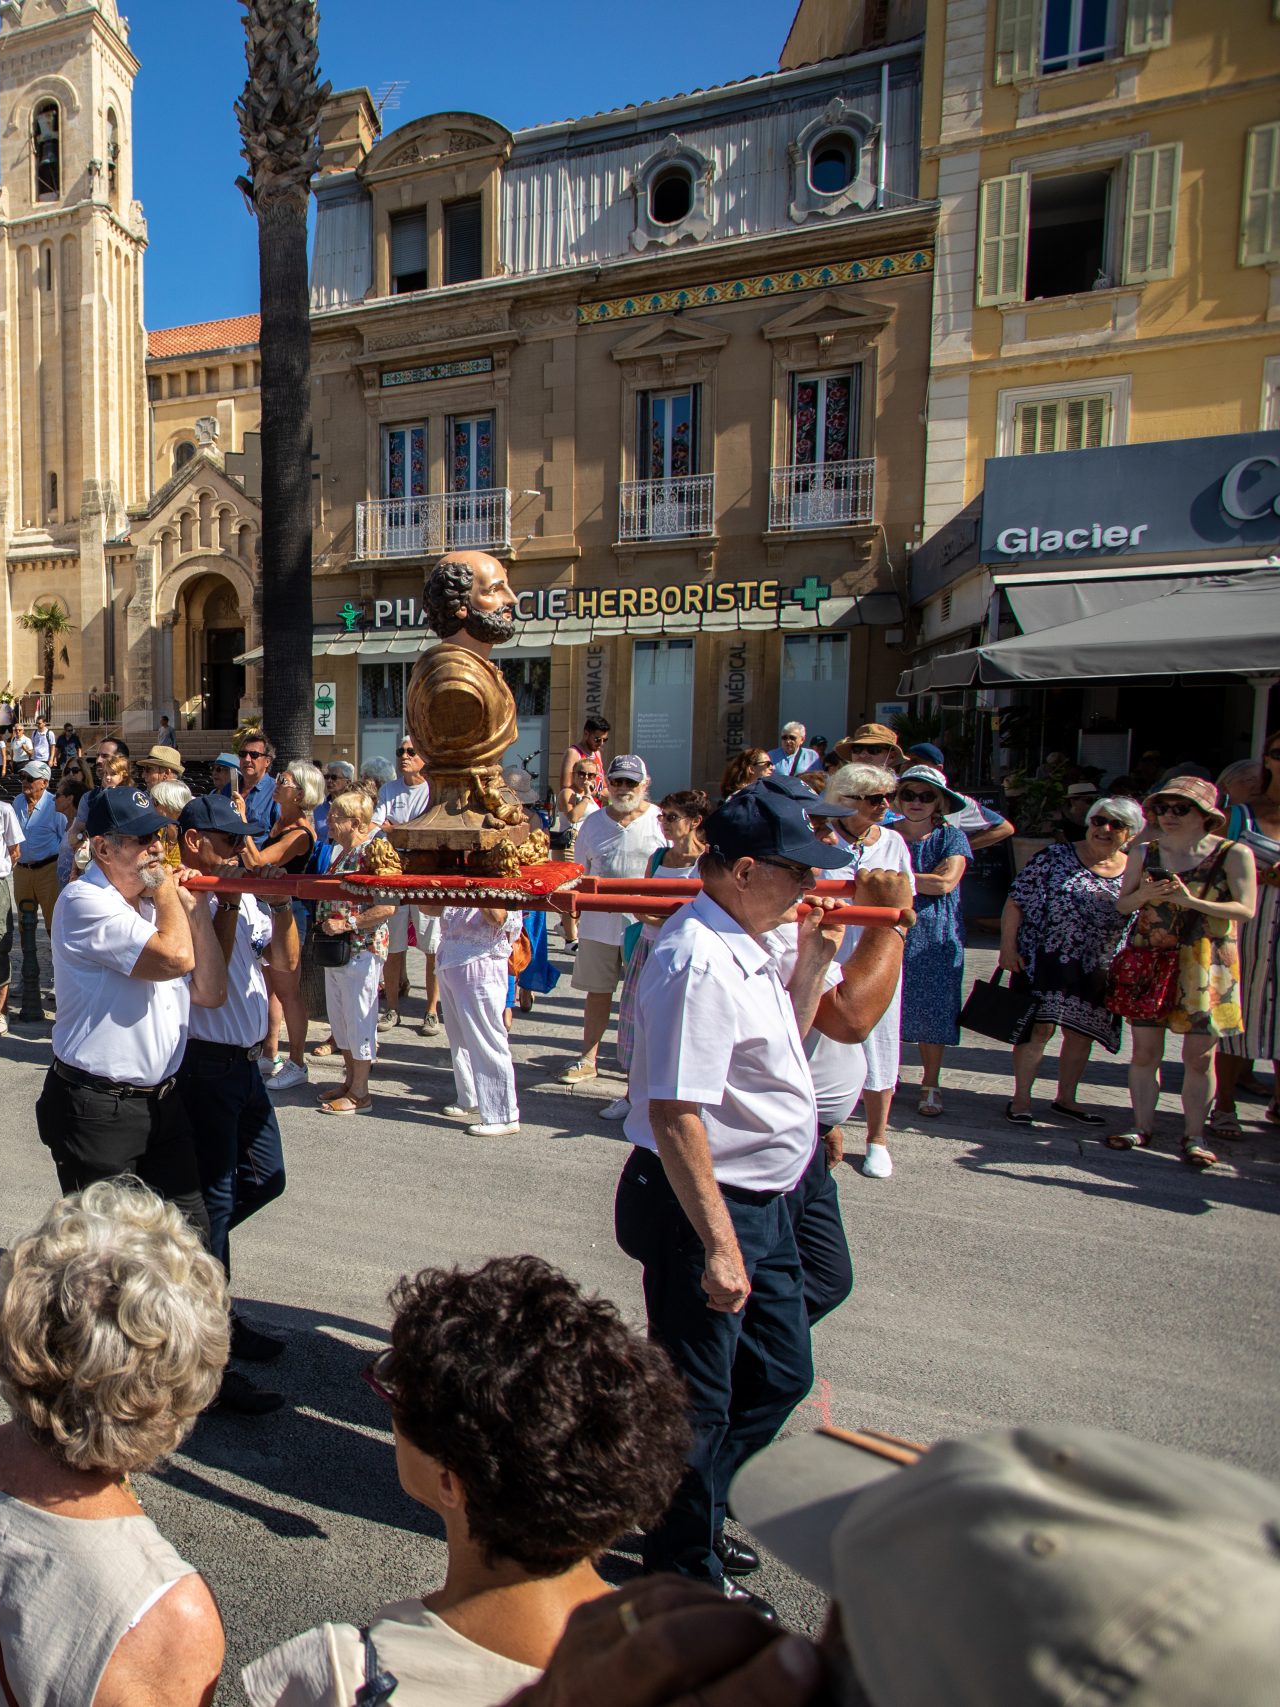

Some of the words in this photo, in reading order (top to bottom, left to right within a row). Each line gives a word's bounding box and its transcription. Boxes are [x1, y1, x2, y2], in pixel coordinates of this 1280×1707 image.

[1222, 456, 1280, 519] C
[996, 523, 1148, 554] Glacier
[375, 589, 567, 628] PHCIE
[577, 579, 780, 619] HERBORISTE
[724, 641, 746, 704] MÉDICAL
